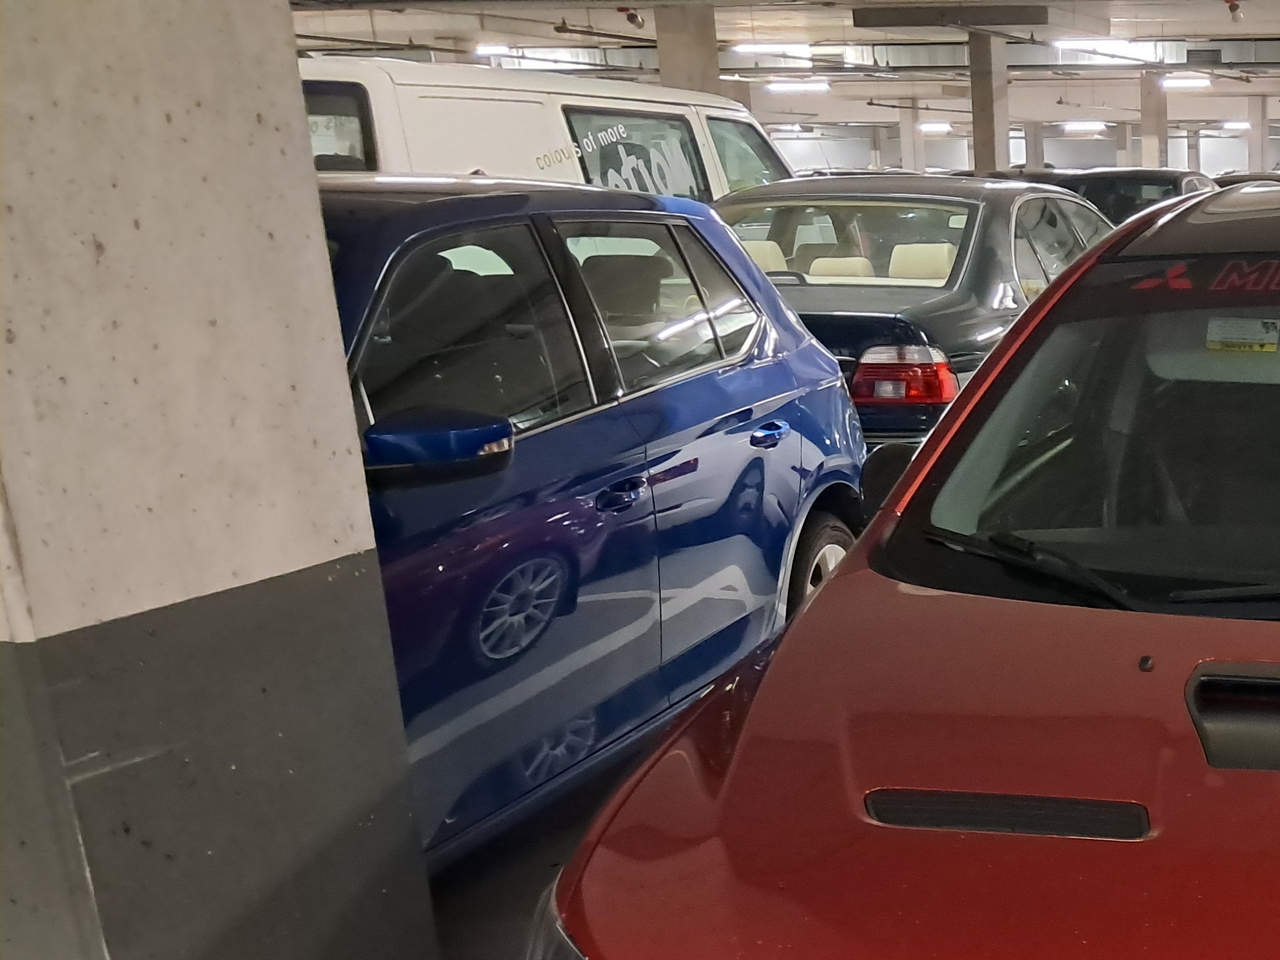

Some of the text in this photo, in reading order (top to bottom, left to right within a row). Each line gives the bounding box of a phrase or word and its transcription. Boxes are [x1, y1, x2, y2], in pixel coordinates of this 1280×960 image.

[536, 123, 628, 170] colous of more
